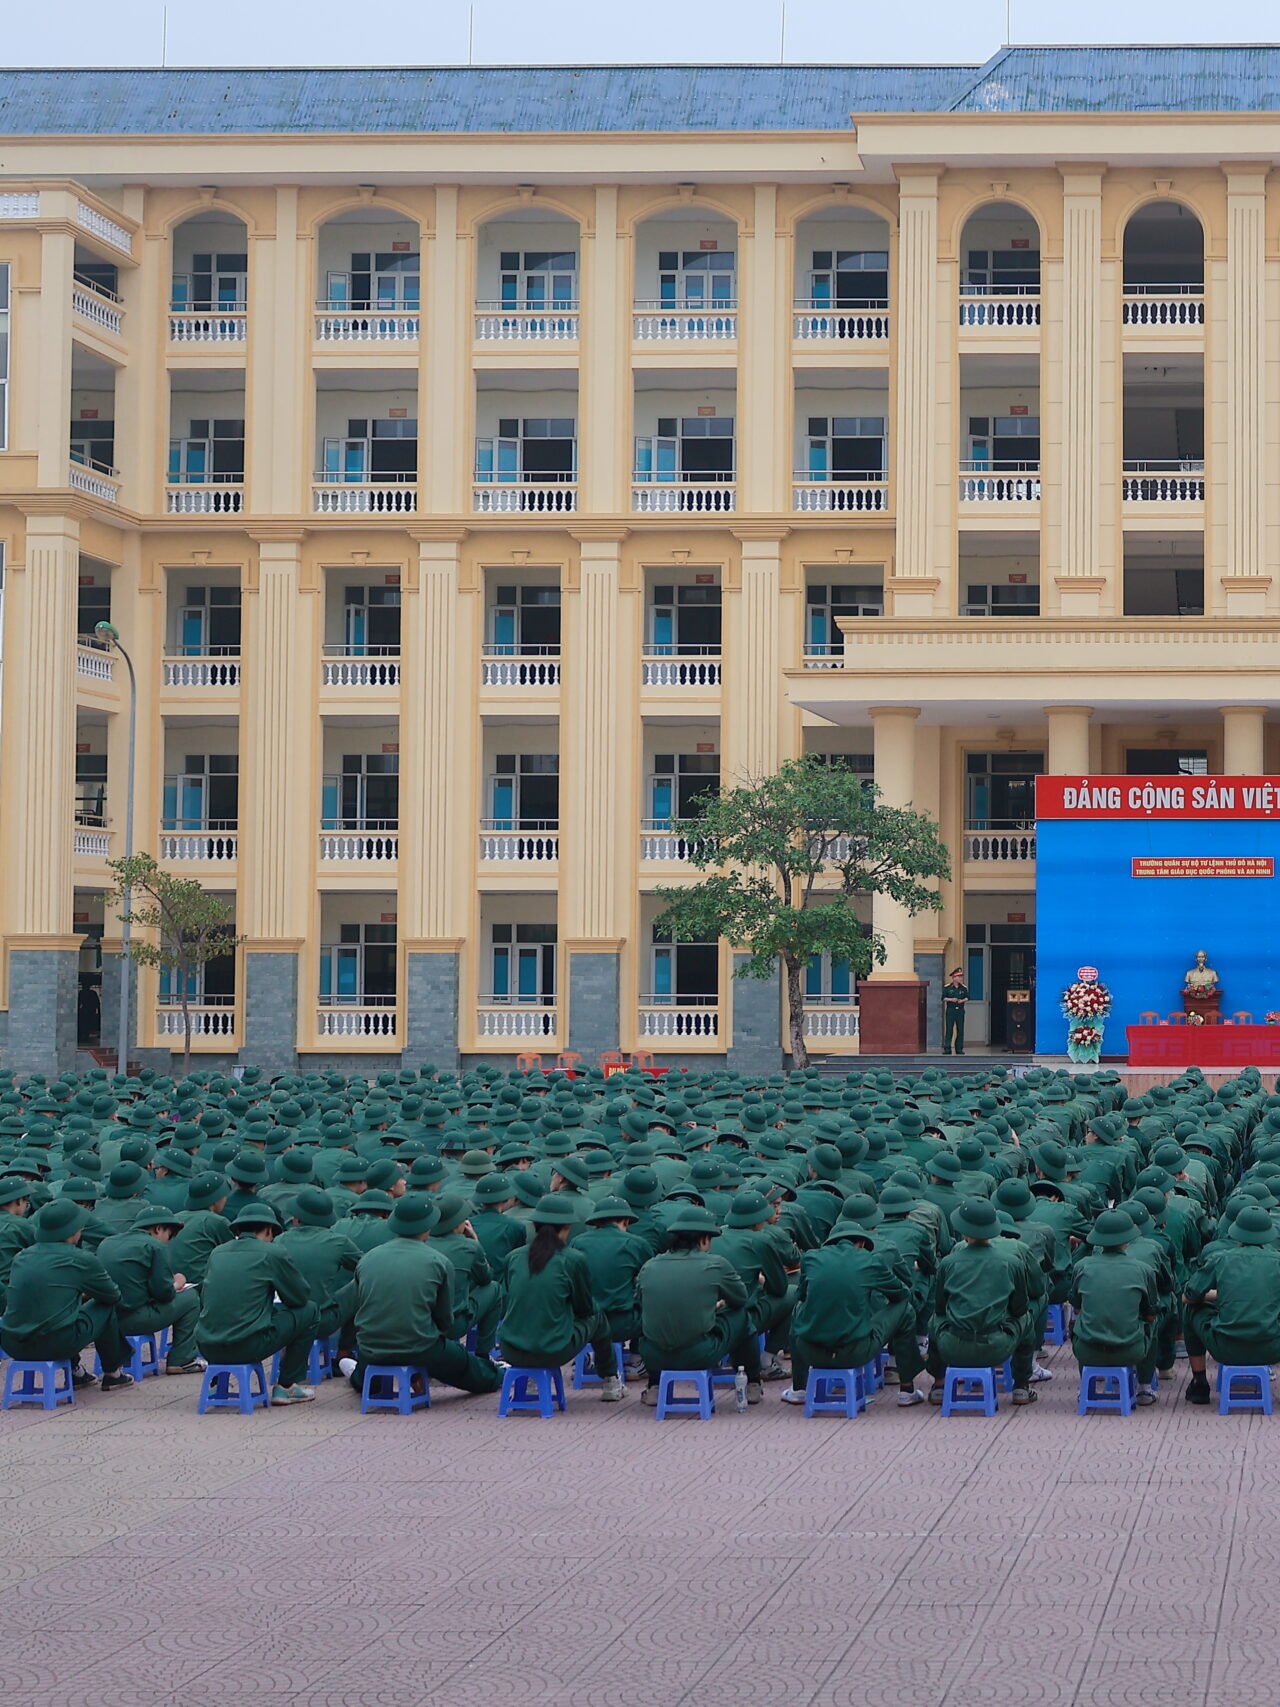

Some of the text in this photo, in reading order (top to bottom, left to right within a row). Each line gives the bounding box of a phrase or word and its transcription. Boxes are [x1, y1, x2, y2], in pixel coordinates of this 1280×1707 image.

[1063, 779, 1121, 809] ĐẢNG
[1128, 782, 1184, 814] CỘNG
[1192, 779, 1235, 809] SẢN
